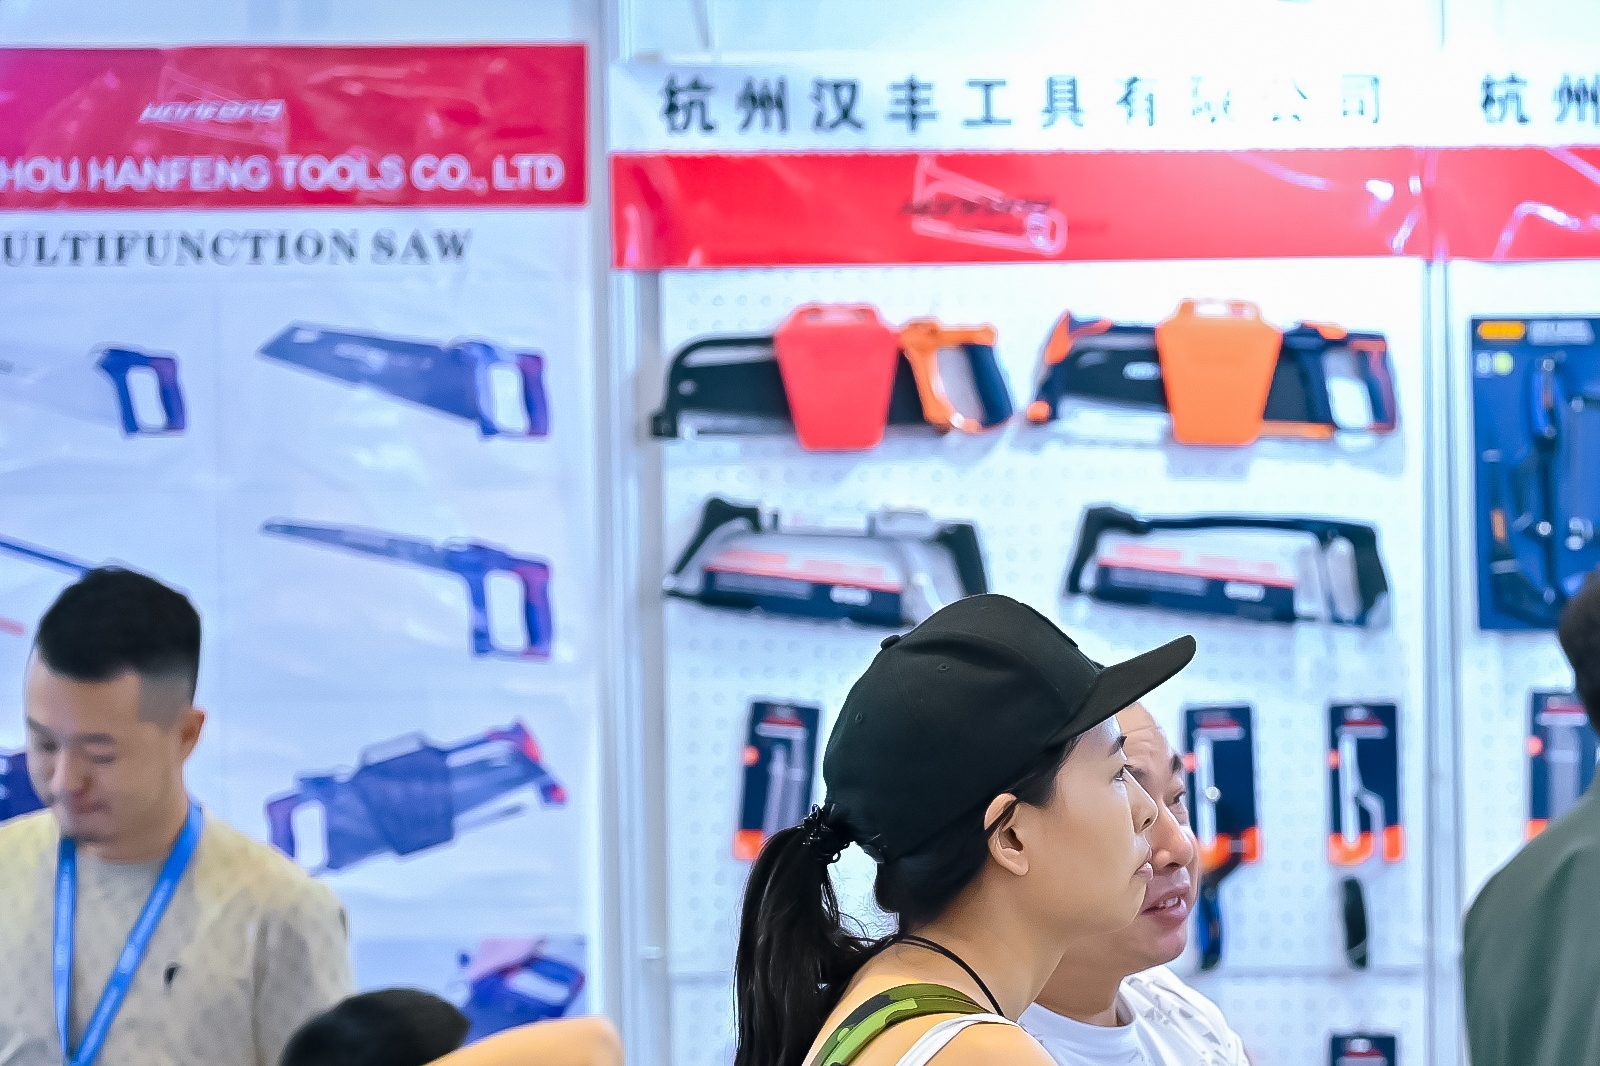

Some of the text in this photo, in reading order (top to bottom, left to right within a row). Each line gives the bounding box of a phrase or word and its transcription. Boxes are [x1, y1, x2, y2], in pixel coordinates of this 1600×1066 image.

[87, 155, 272, 192] HANFENG
[277, 154, 405, 191] TOOLS
[492, 154, 565, 190] LTD
[370, 228, 474, 266] SAW
